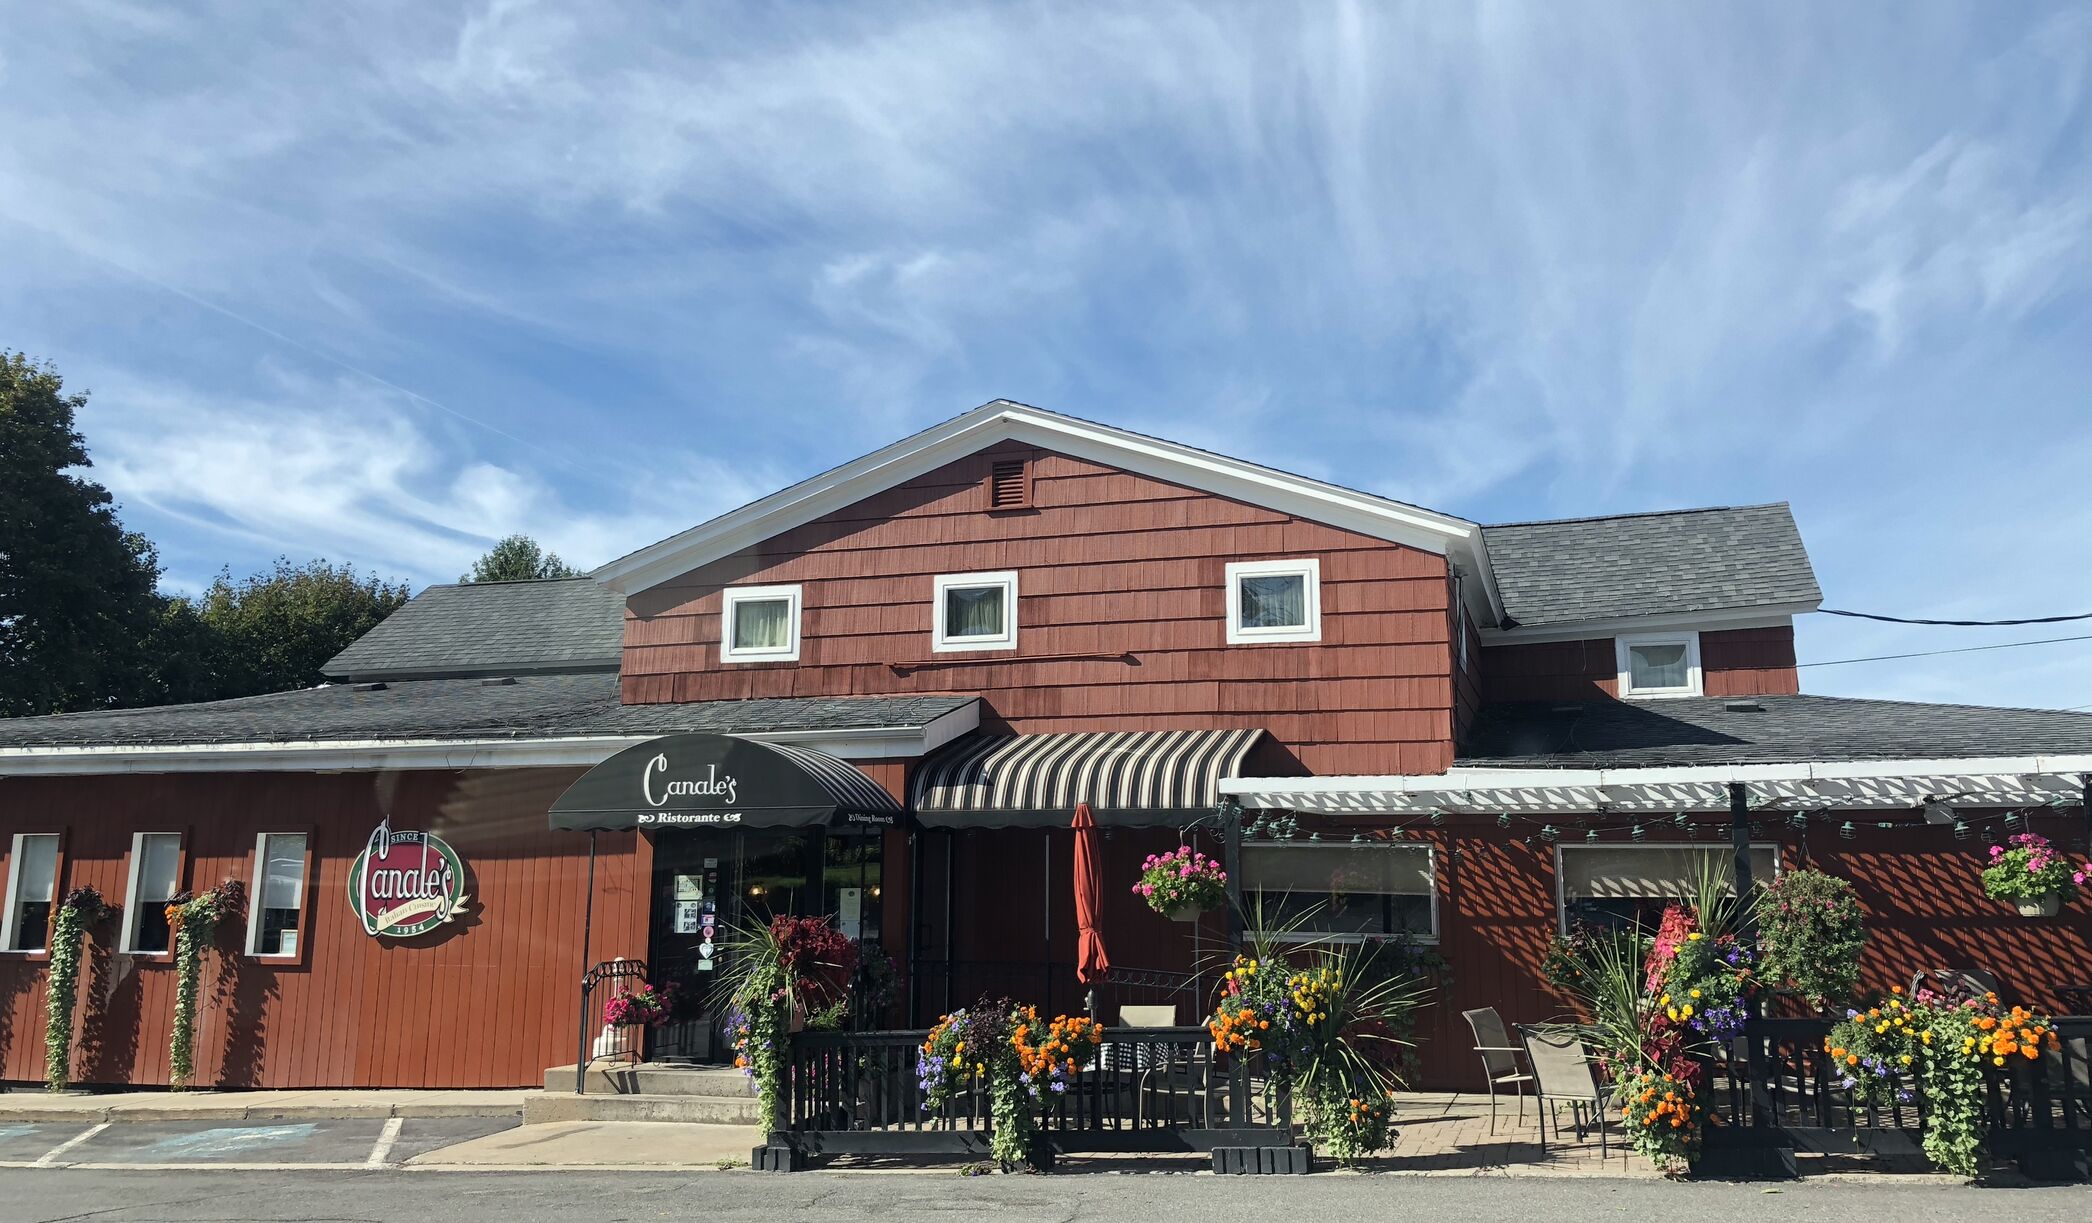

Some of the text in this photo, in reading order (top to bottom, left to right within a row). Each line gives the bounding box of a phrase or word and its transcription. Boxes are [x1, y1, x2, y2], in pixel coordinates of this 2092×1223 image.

[643, 753, 737, 806] Canale's
[657, 812, 721, 823] Ristorante
[855, 813, 886, 824] Dining Room
[391, 832, 419, 843] SINCE
[360, 816, 452, 935] Canale's
[396, 924, 425, 934] 1954
